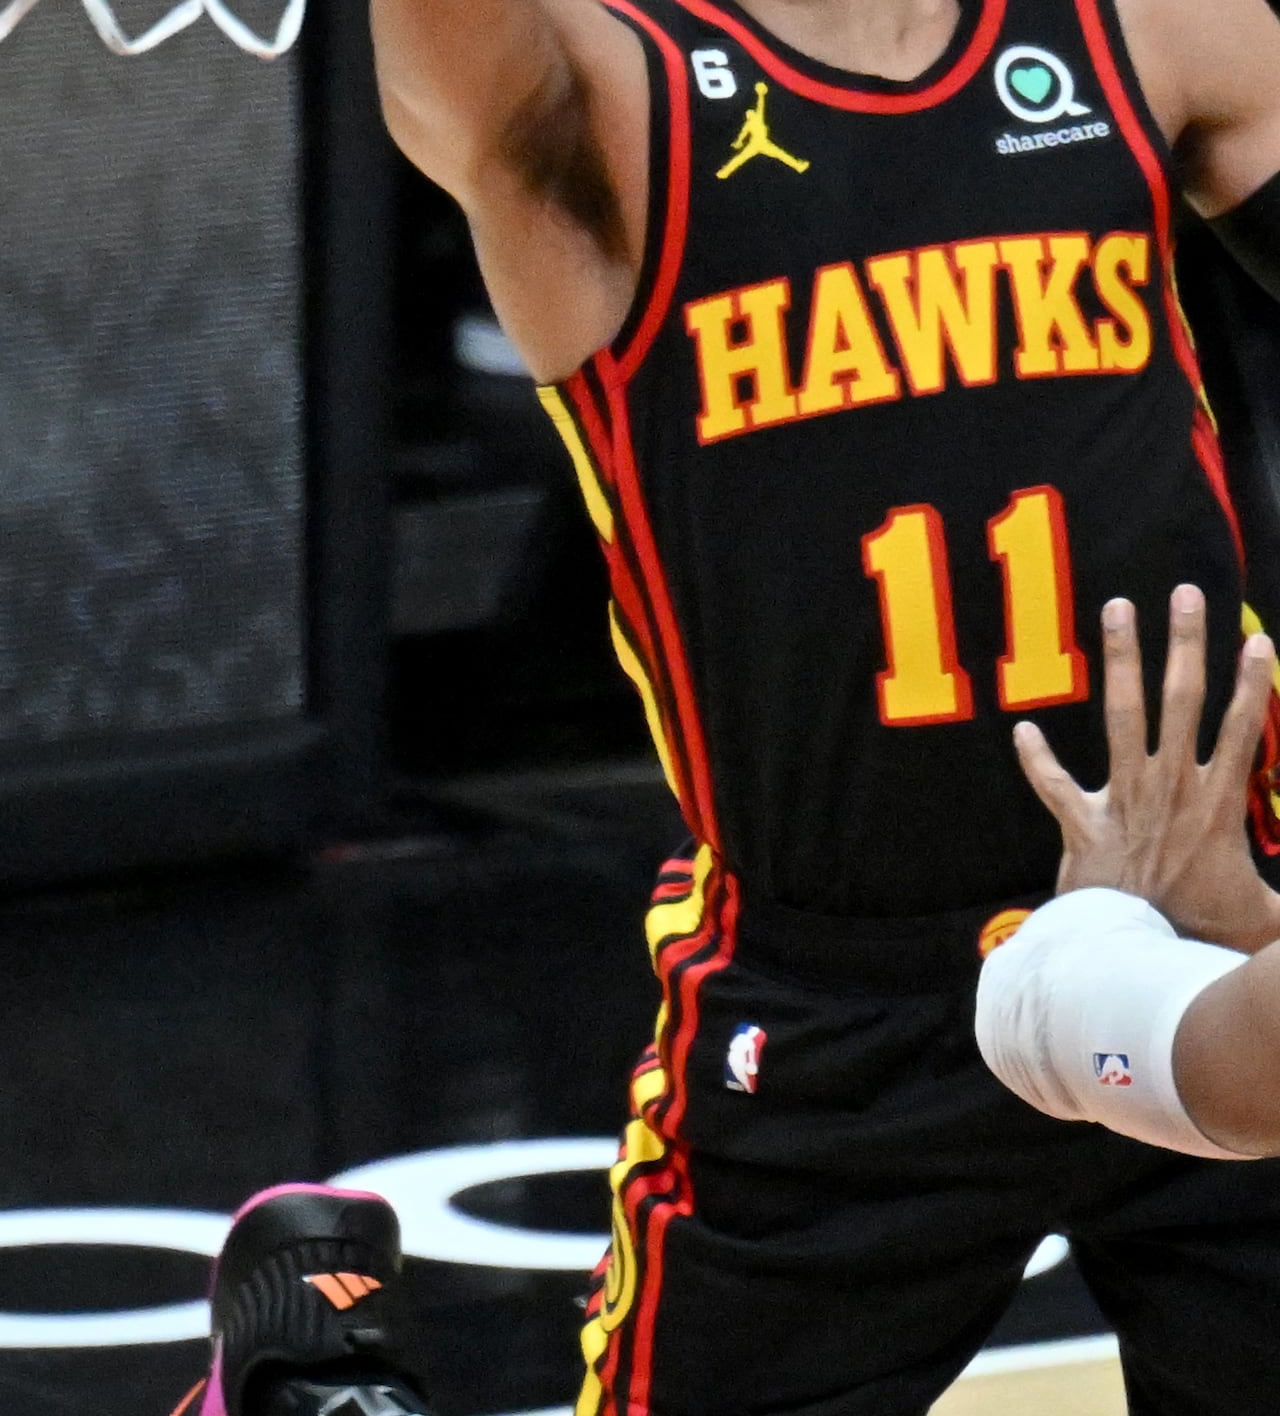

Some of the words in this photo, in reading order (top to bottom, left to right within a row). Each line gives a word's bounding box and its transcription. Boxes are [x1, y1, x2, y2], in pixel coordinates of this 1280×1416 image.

[690, 48, 737, 99] 6
[995, 122, 1110, 154] sharecare
[683, 231, 1152, 447] HAWKS
[860, 484, 1089, 727] 11
